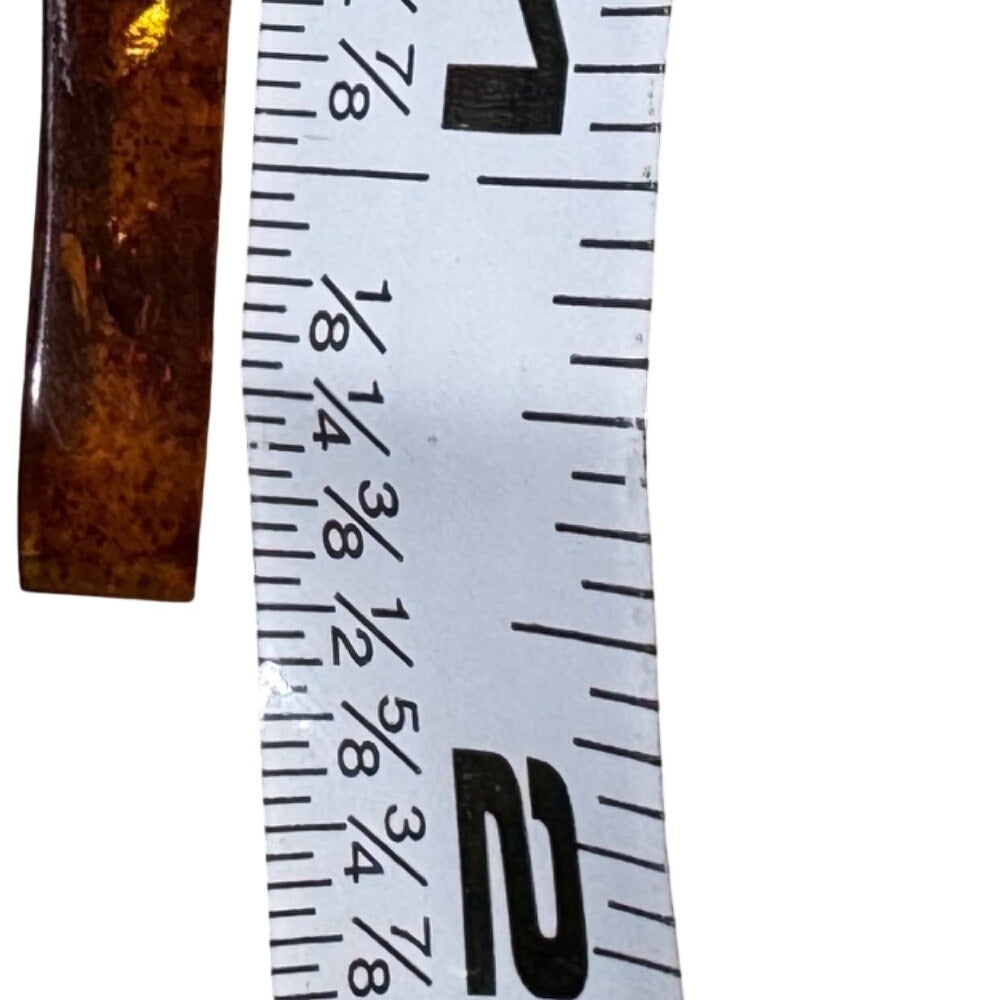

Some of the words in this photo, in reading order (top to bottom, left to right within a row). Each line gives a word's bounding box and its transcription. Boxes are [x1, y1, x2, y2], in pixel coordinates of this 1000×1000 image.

[329, 39, 414, 120] 7/8
[309, 275, 392, 354] 1/8
[313, 378, 390, 456] 1/4
[323, 480, 403, 562] 3/8
[331, 592, 413, 667] 1/2
[338, 696, 421, 777] 5/8
[344, 805, 428, 886] 3/4
[452, 748, 588, 999] 2
[348, 917, 432, 997] 7/8
